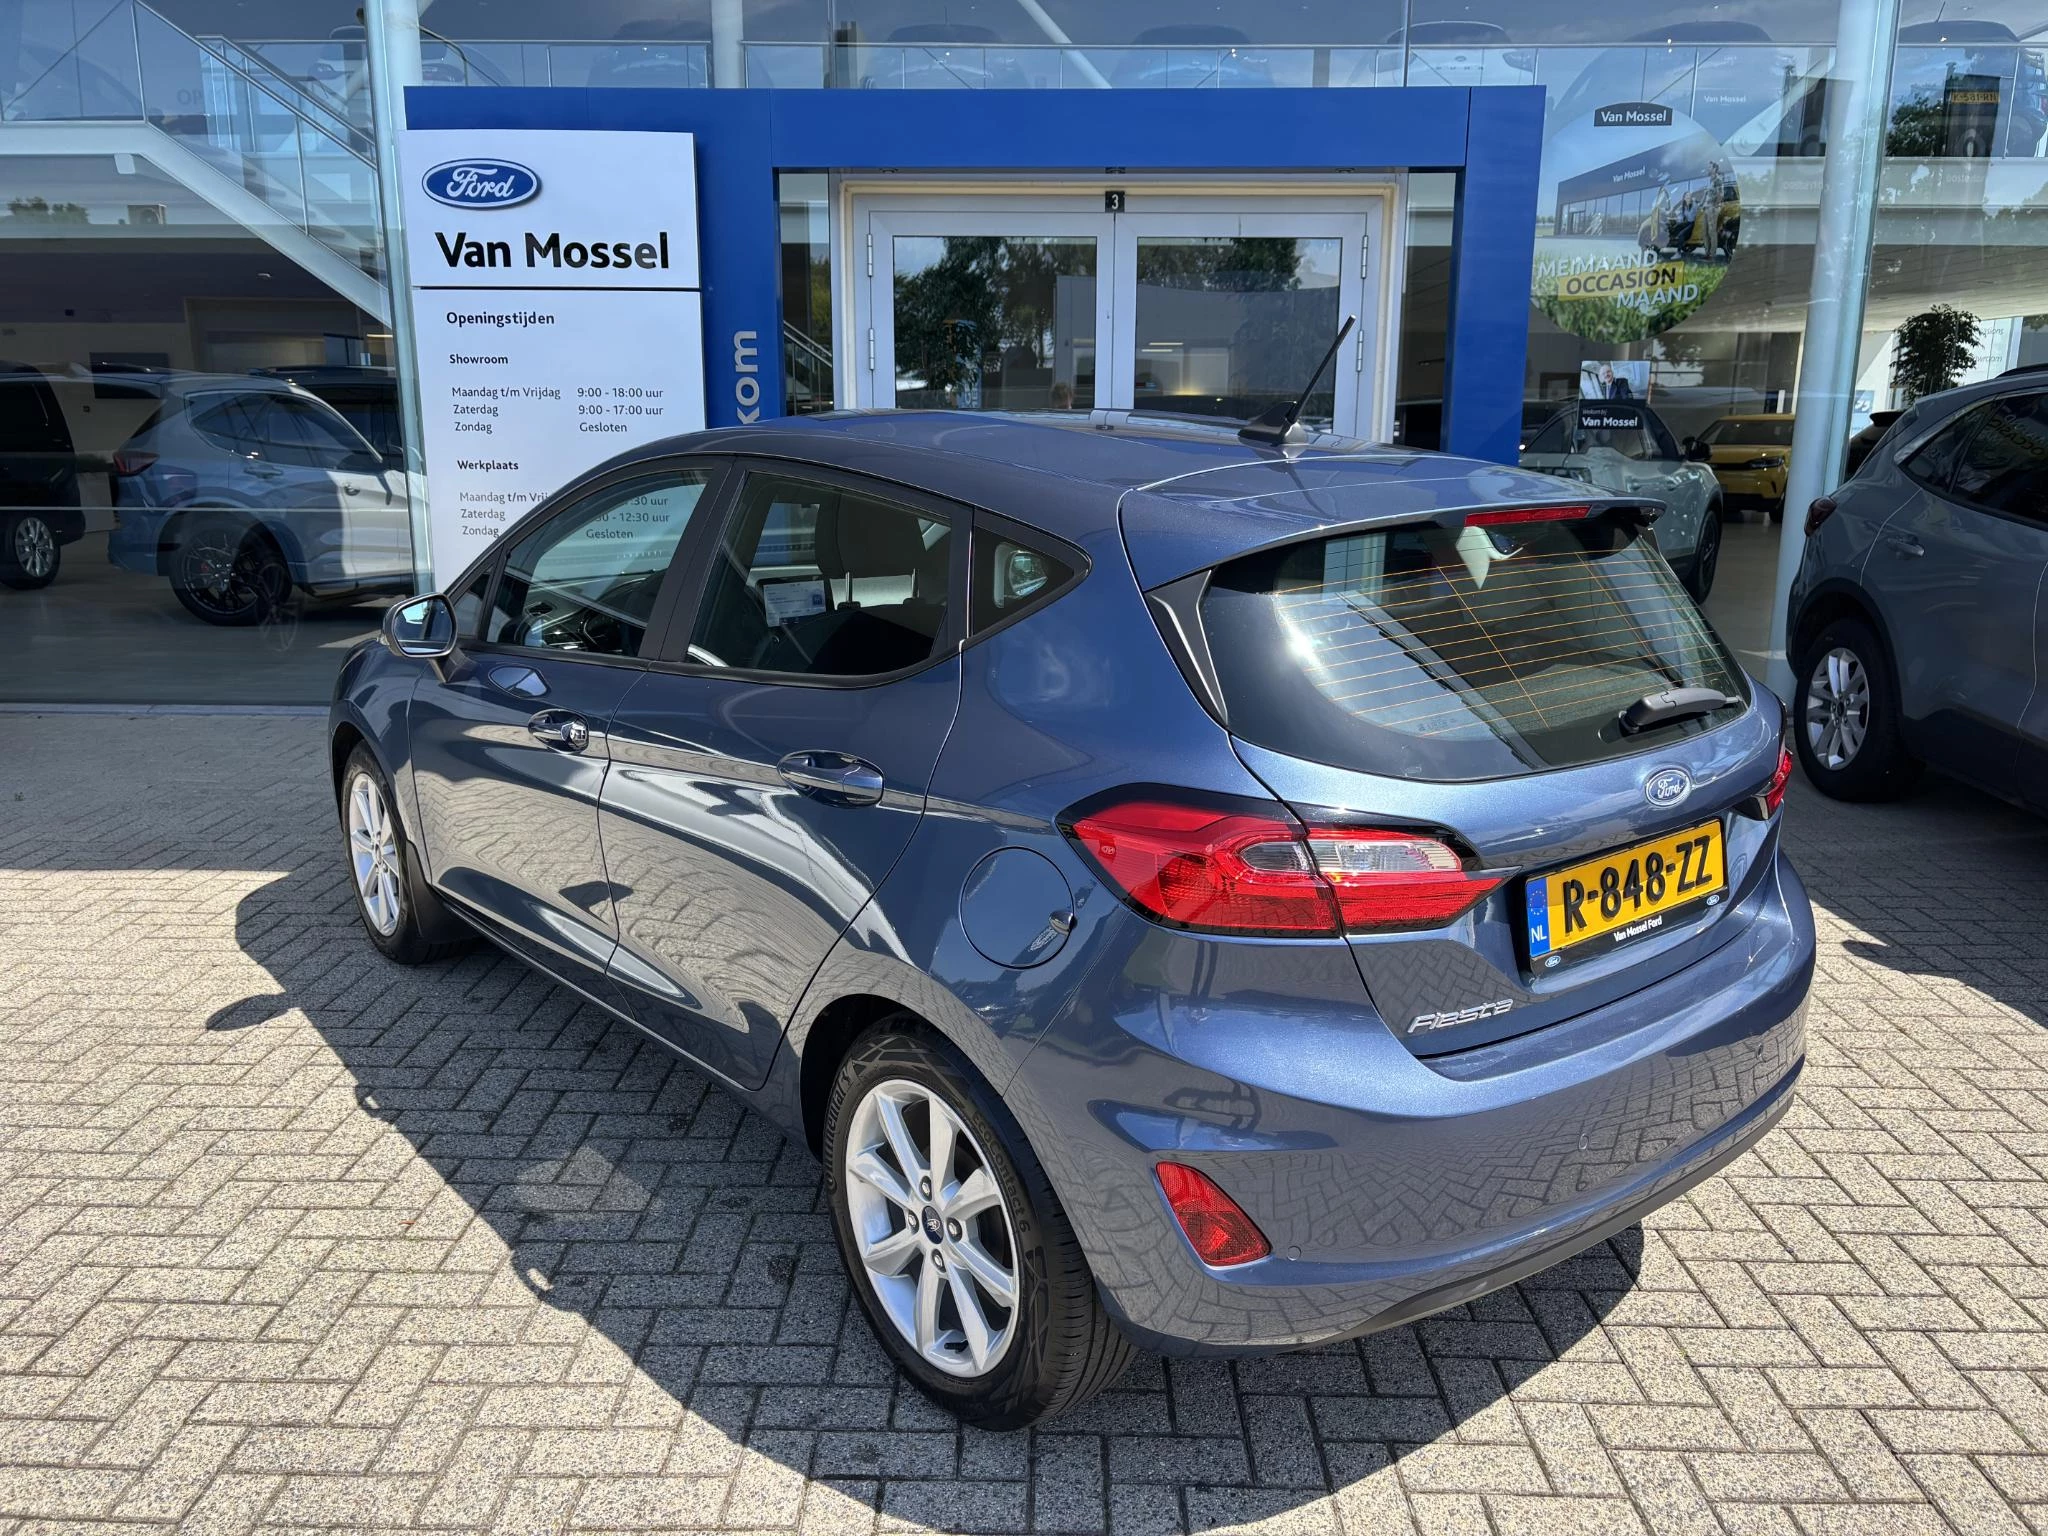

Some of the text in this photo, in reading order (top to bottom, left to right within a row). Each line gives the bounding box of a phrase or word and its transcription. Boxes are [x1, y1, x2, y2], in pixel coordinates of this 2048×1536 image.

[1601, 110, 1667, 122] Van Mossel
[1612, 166, 1646, 183] Van Mossel
[446, 166, 516, 200] Ford
[1111, 193, 1119, 210] 3
[434, 231, 669, 269] Van Mossel
[1566, 267, 1677, 295] OCCASION
[1616, 283, 1699, 309] MAAND
[446, 311, 555, 327] Openingstijden
[449, 354, 509, 365] Showroom
[452, 387, 561, 400] Maandag t/m Vrijdag
[577, 387, 602, 398] 9:00
[612, 387, 643, 398] 18:00
[645, 390, 664, 398] uur
[453, 404, 499, 417] Zaterdag
[578, 404, 603, 415] 9:00
[613, 405, 643, 415] 17:00
[645, 407, 664, 415] uur
[454, 421, 493, 435] Zondag
[579, 421, 628, 432] Gesloten
[1582, 416, 1638, 427] Van Mossel
[457, 460, 519, 472] Werkplaats
[459, 491, 506, 505] Maandag
[507, 492, 527, 502] t/m
[650, 498, 669, 506] uur
[460, 508, 506, 522] Zaterdag
[619, 512, 649, 522] 12:30
[652, 514, 671, 522] uur
[462, 525, 500, 538] Zondag
[586, 528, 634, 539] Gesloten
[1563, 835, 1713, 937] R-848-ZZ
[1531, 924, 1547, 943] NL
[1613, 915, 1663, 942] Van Mossel Ford
[1408, 999, 1513, 1033] Fiesta
